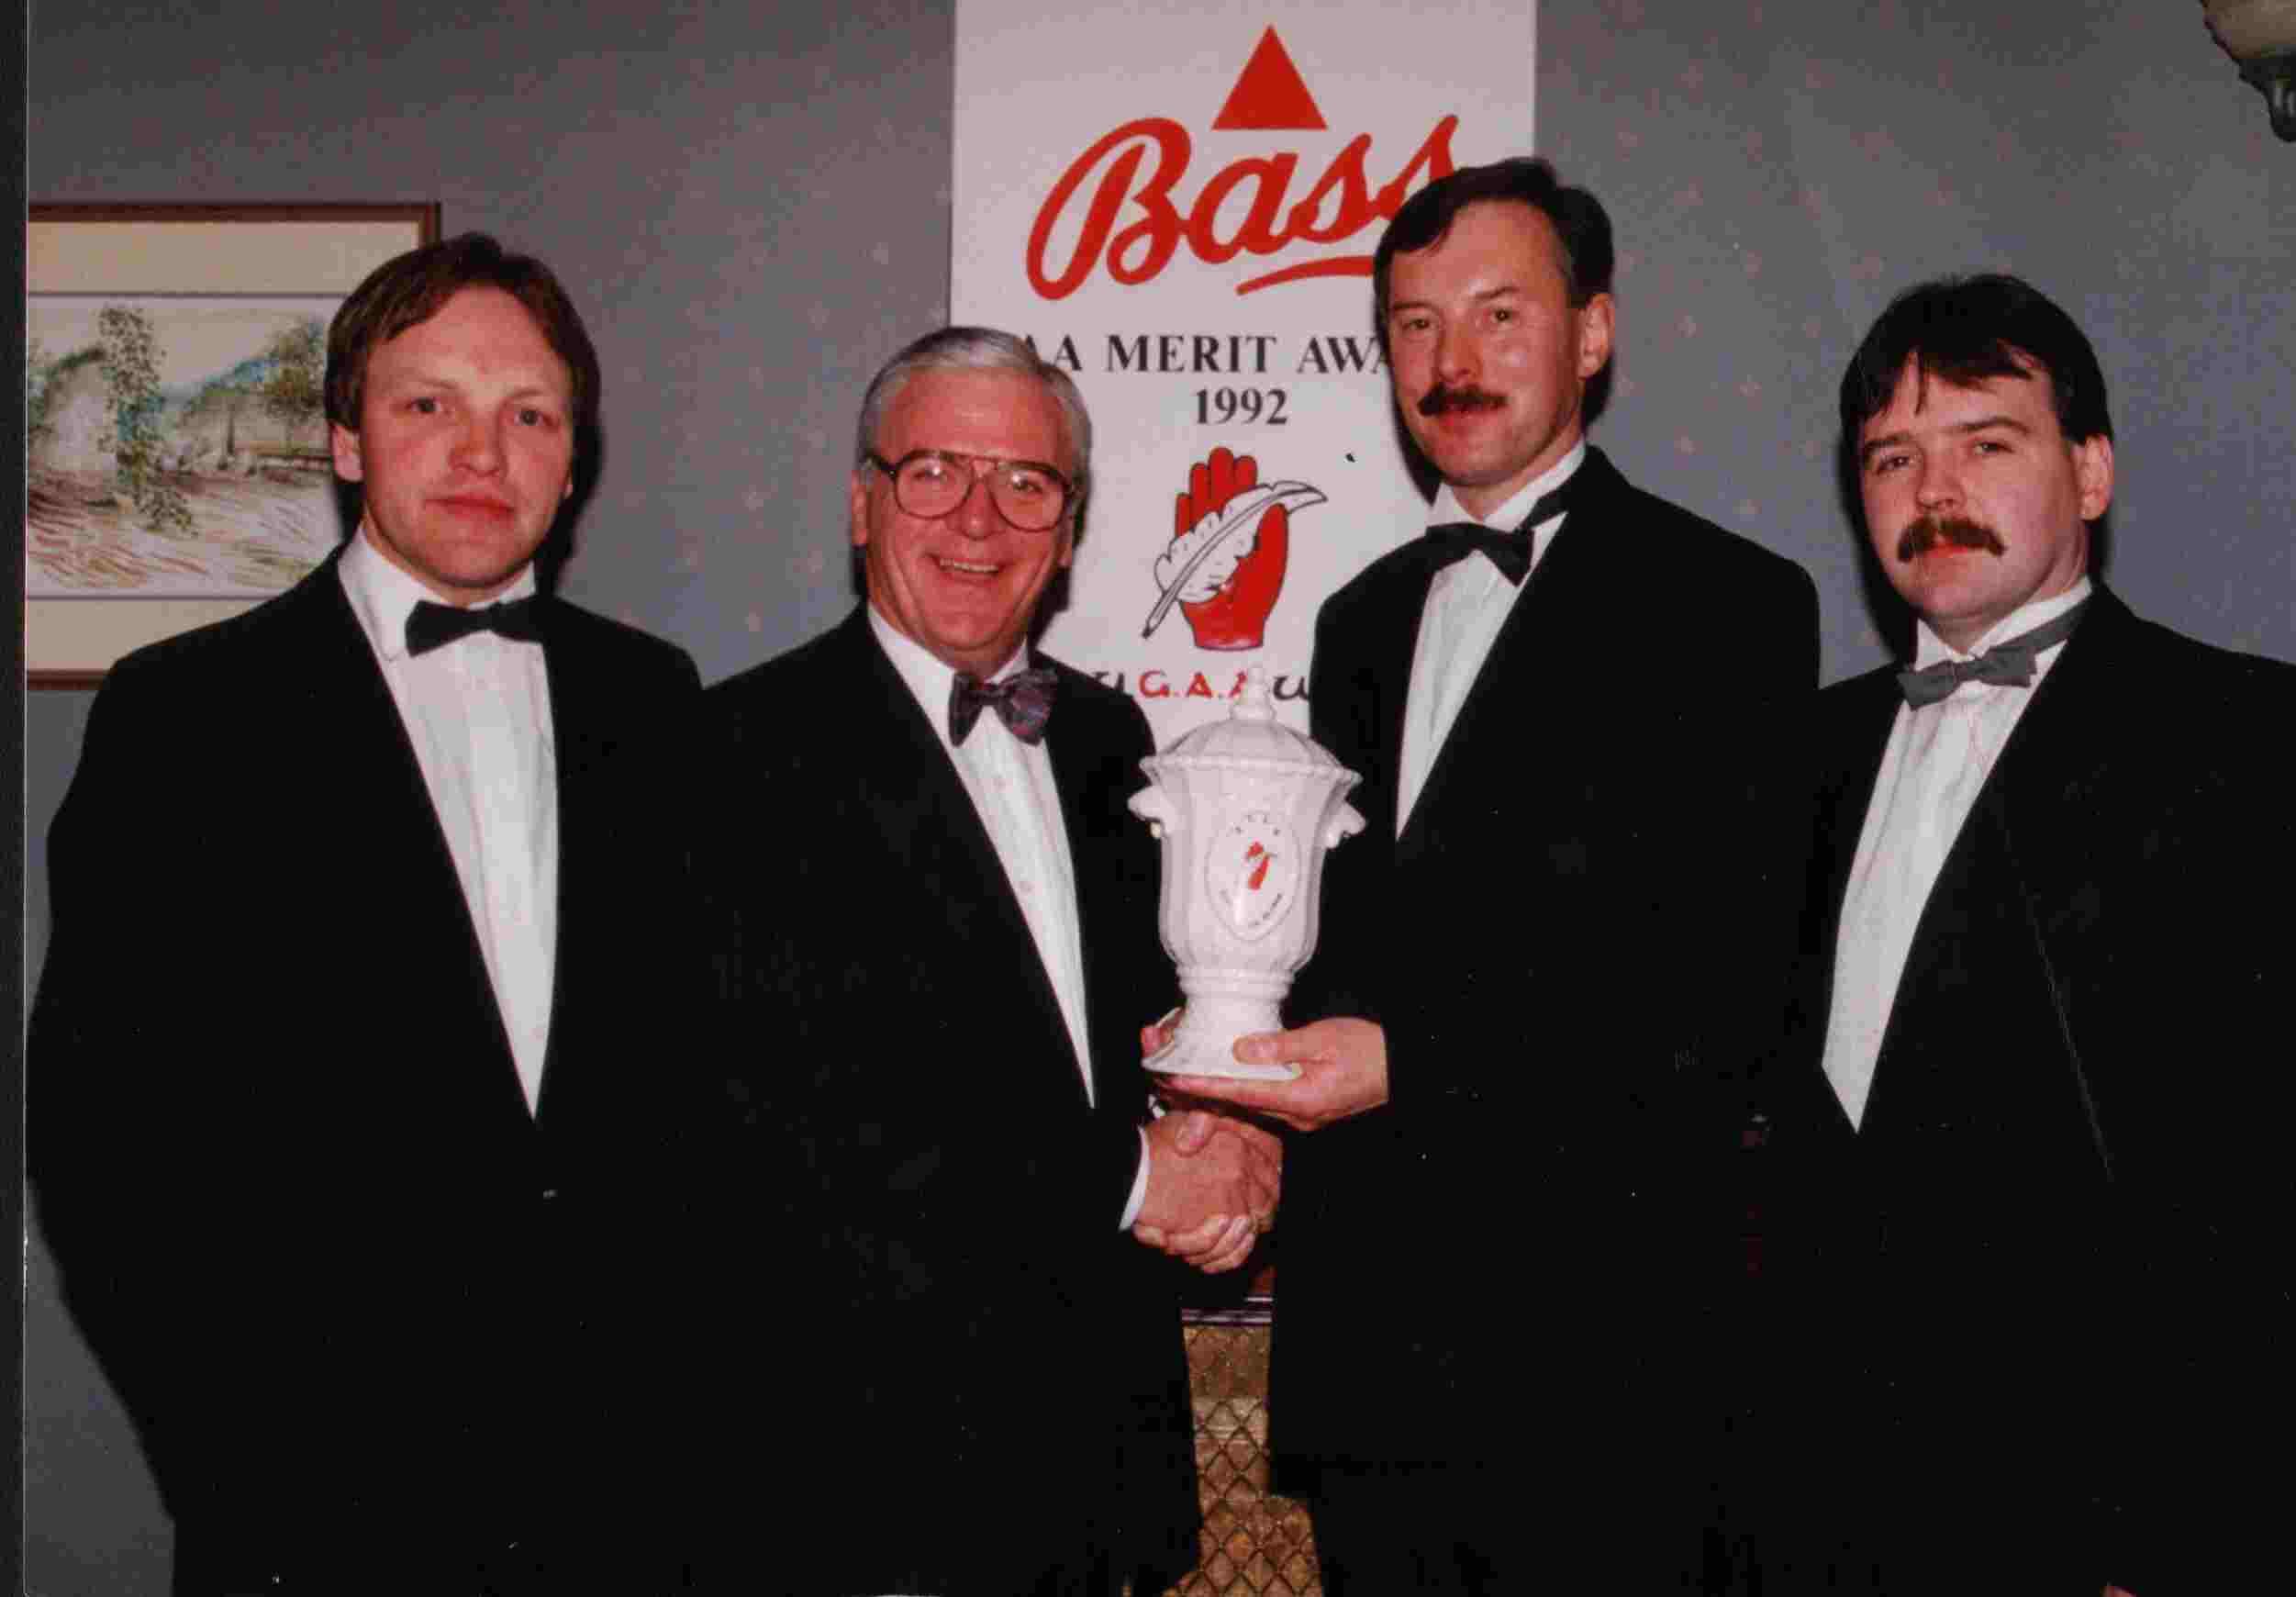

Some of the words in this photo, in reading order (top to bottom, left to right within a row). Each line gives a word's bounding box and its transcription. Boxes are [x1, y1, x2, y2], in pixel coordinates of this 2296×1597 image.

[1026, 114, 1459, 301] Bass
[1106, 333, 1277, 374] MERIT
[1296, 335, 1387, 374] AW
[1194, 387, 1288, 426] 1992
